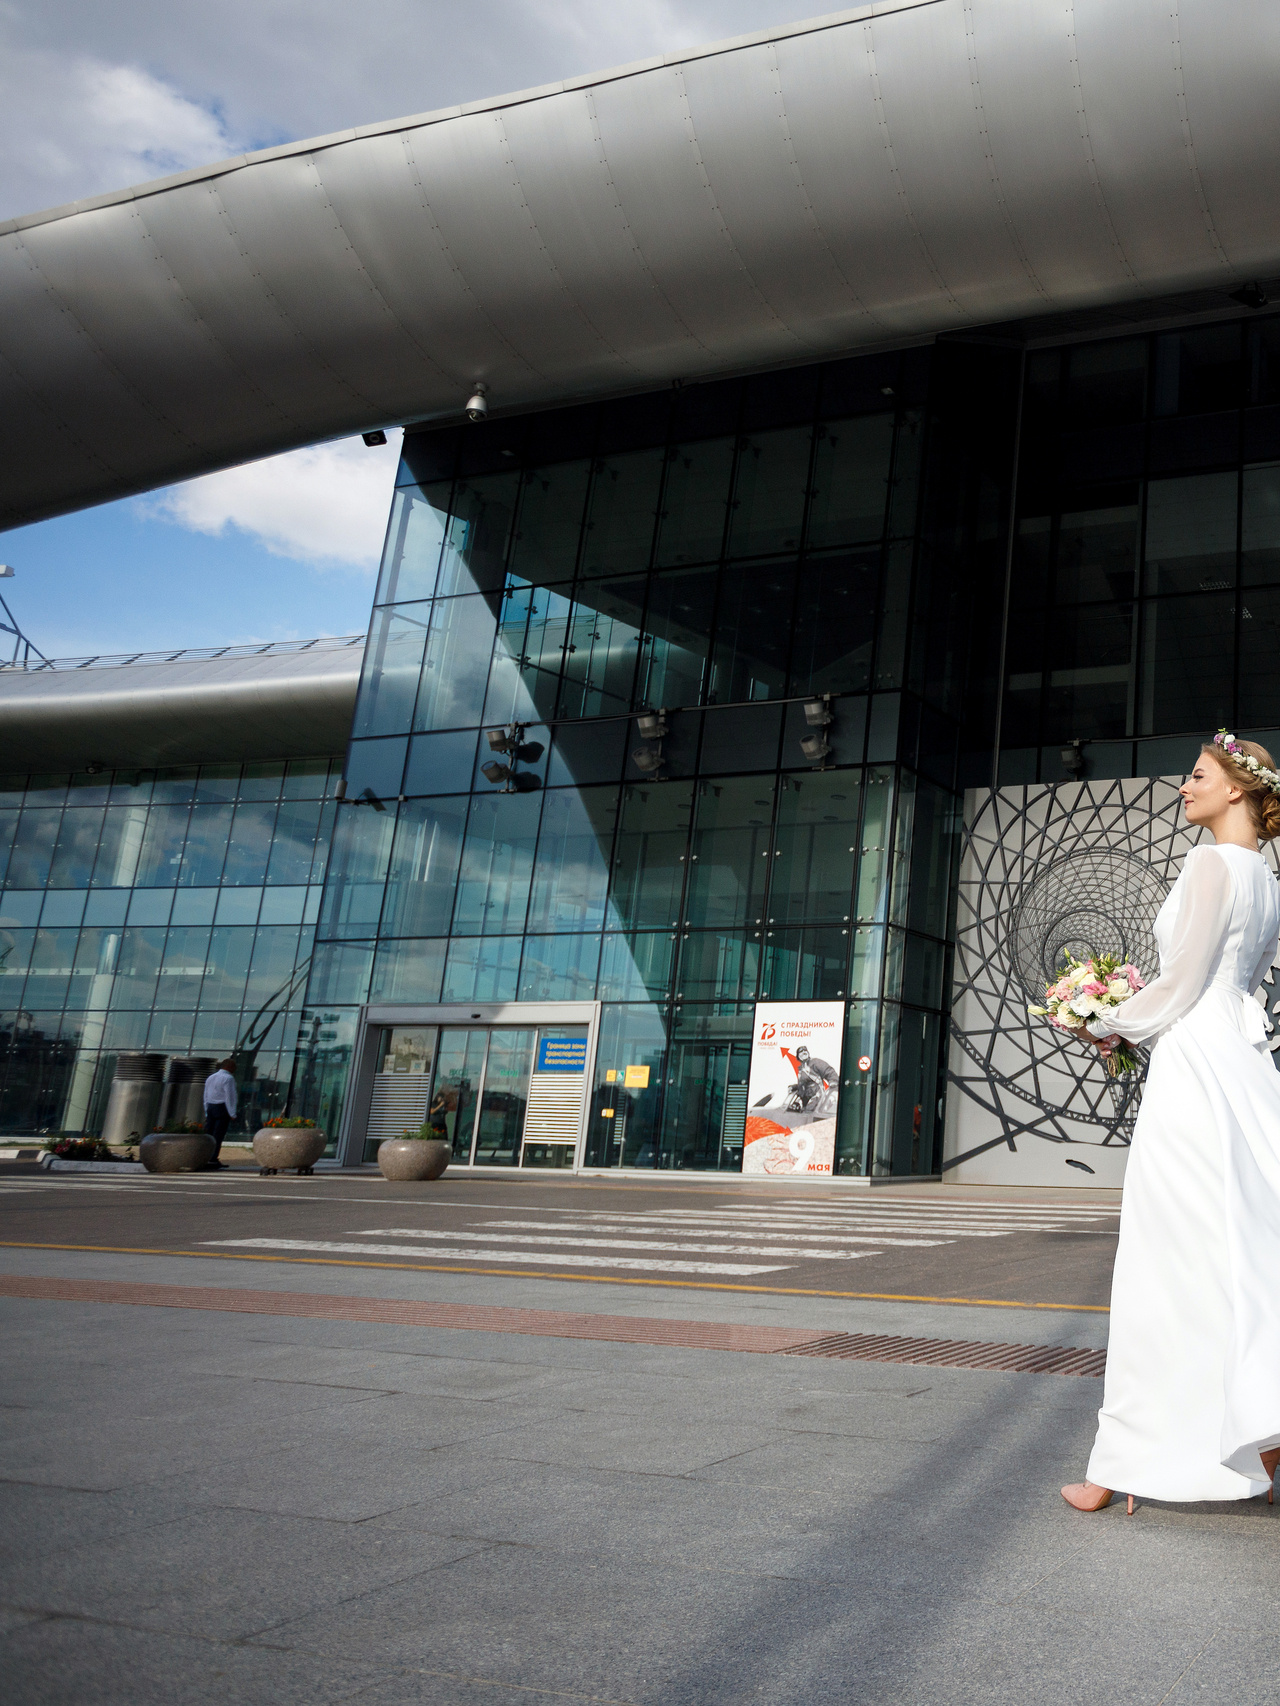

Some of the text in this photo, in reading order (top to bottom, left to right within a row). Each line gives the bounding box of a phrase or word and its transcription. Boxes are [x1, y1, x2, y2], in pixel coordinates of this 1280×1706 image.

[786, 1021, 835, 1029] ПРАЗДНИКОМ
[780, 1030, 812, 1038] ПОБЕДЫ!
[788, 1130, 815, 1171] 9
[807, 1163, 831, 1172] мая
